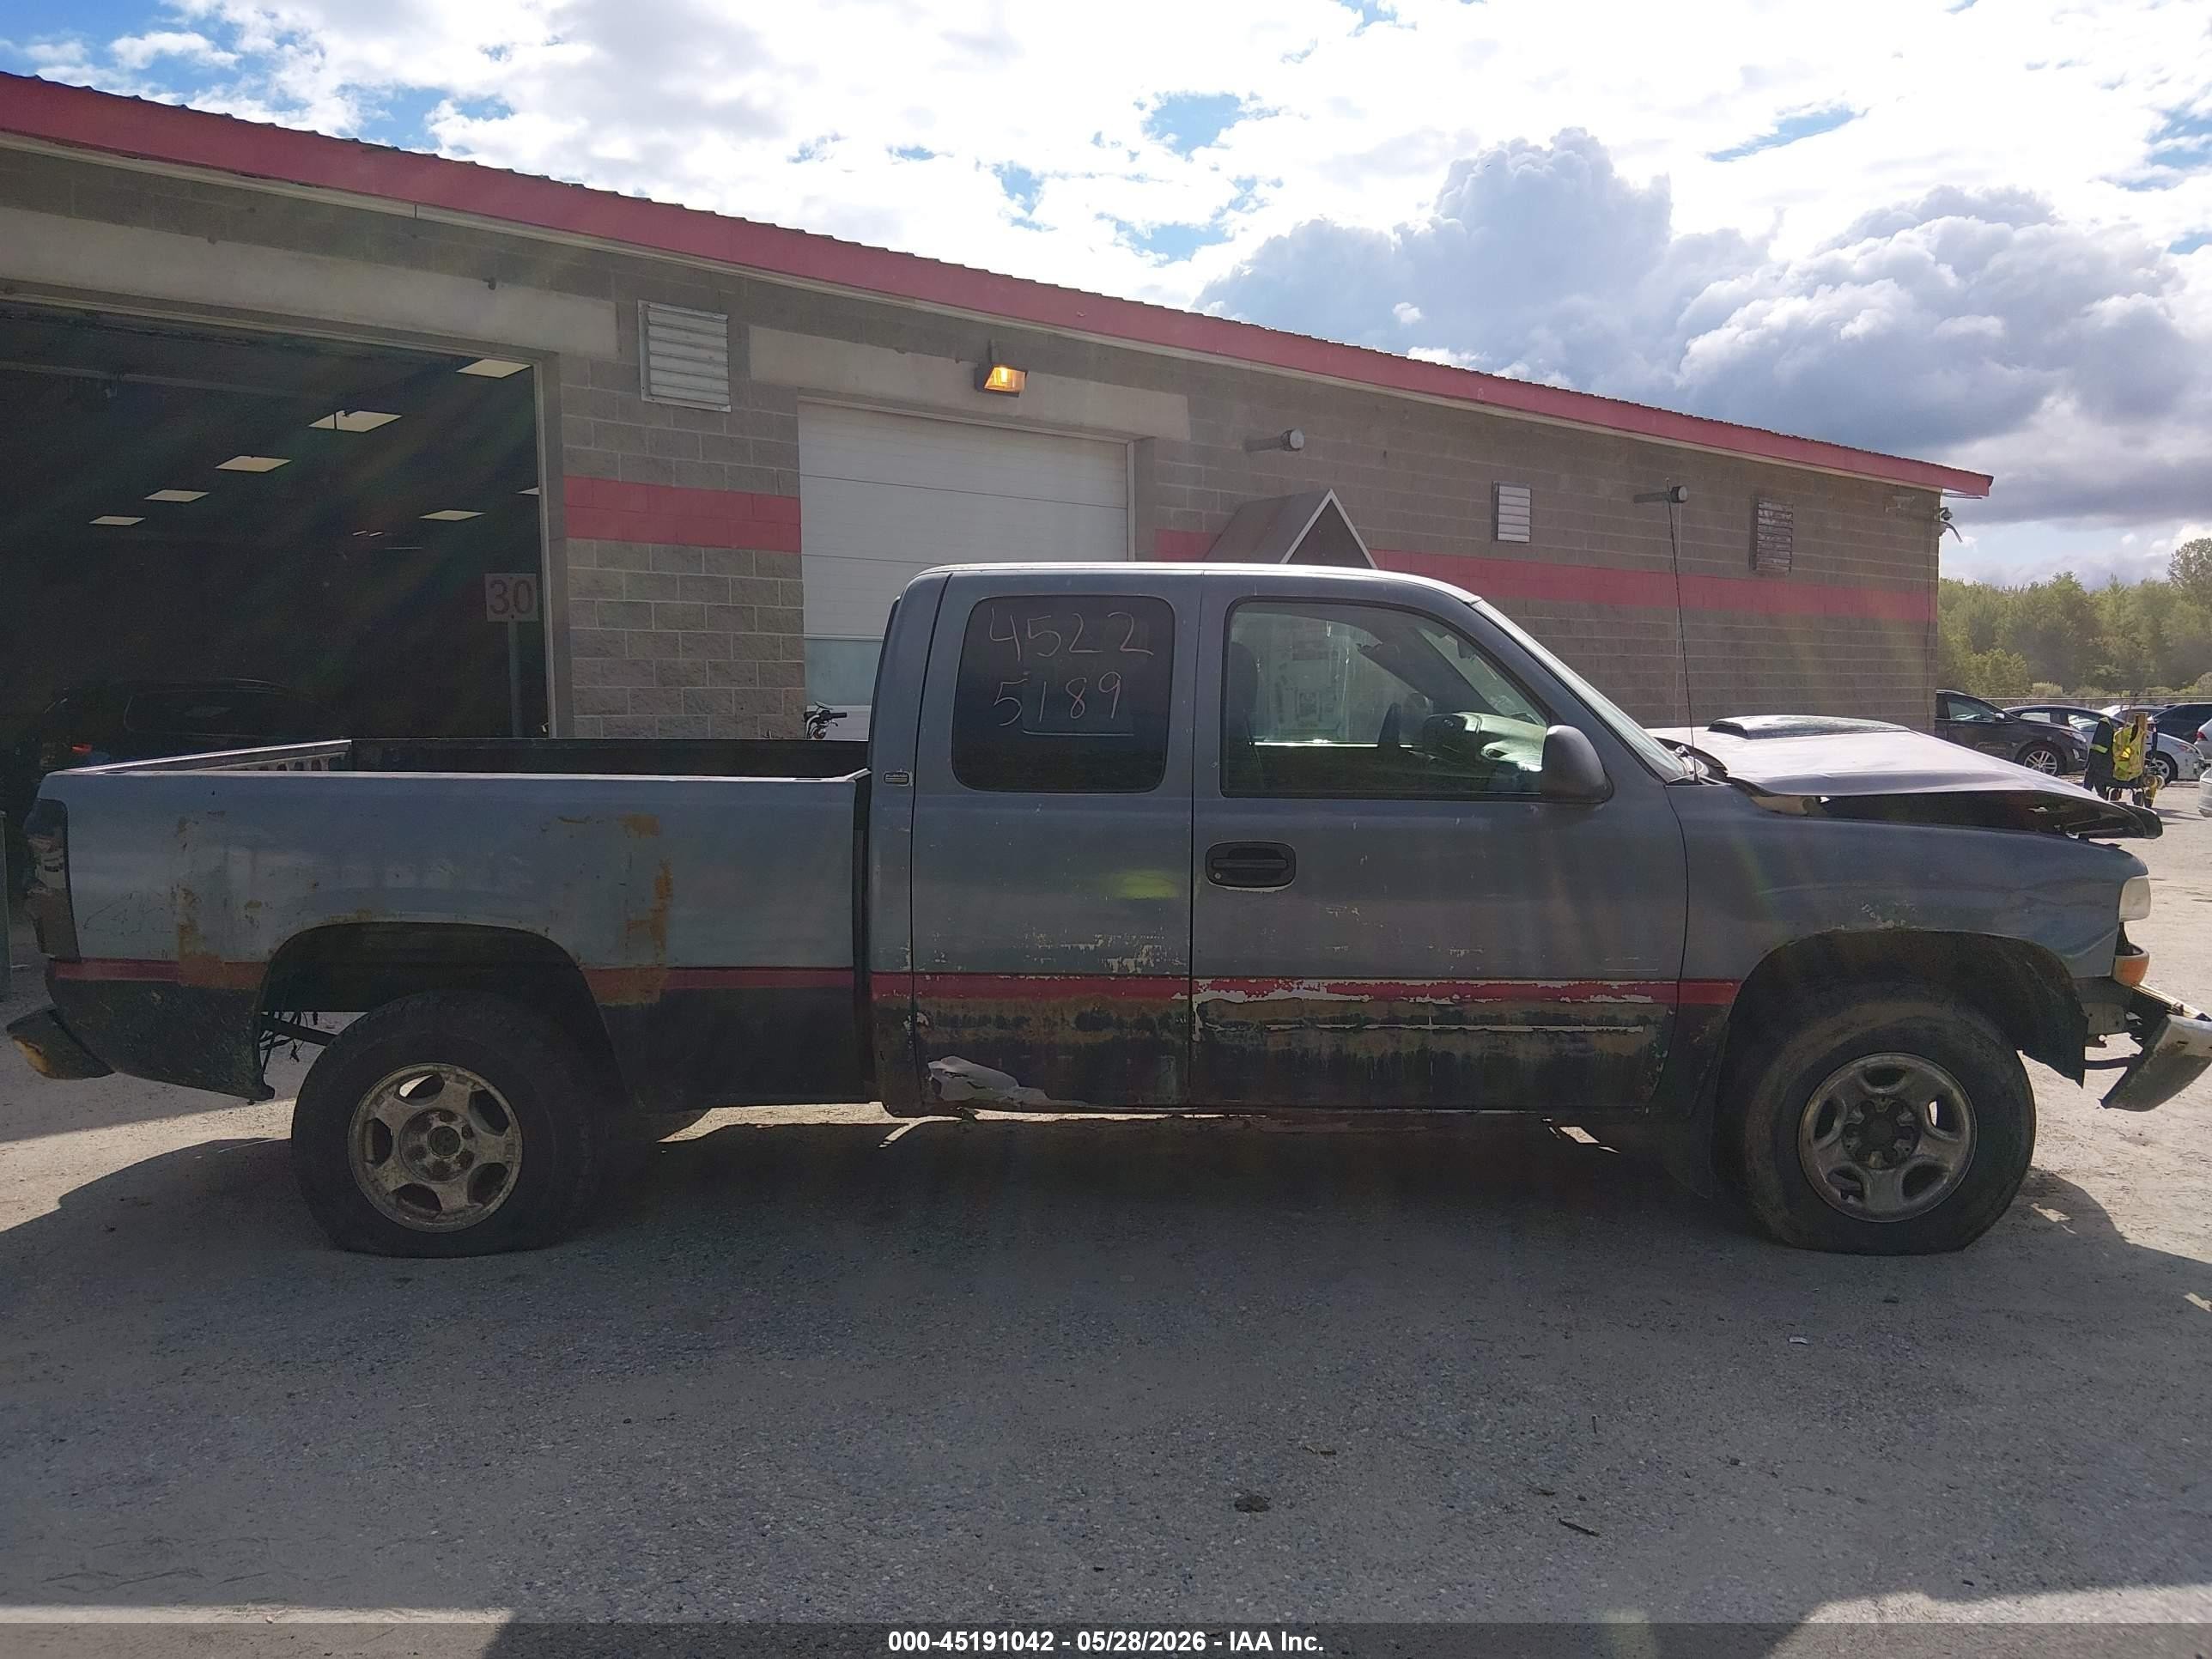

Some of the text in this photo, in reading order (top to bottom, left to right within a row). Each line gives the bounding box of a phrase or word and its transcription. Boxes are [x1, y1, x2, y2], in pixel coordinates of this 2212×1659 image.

[489, 579, 534, 616] 30
[988, 606, 1155, 661] 4522
[993, 671, 1122, 726] 5189
